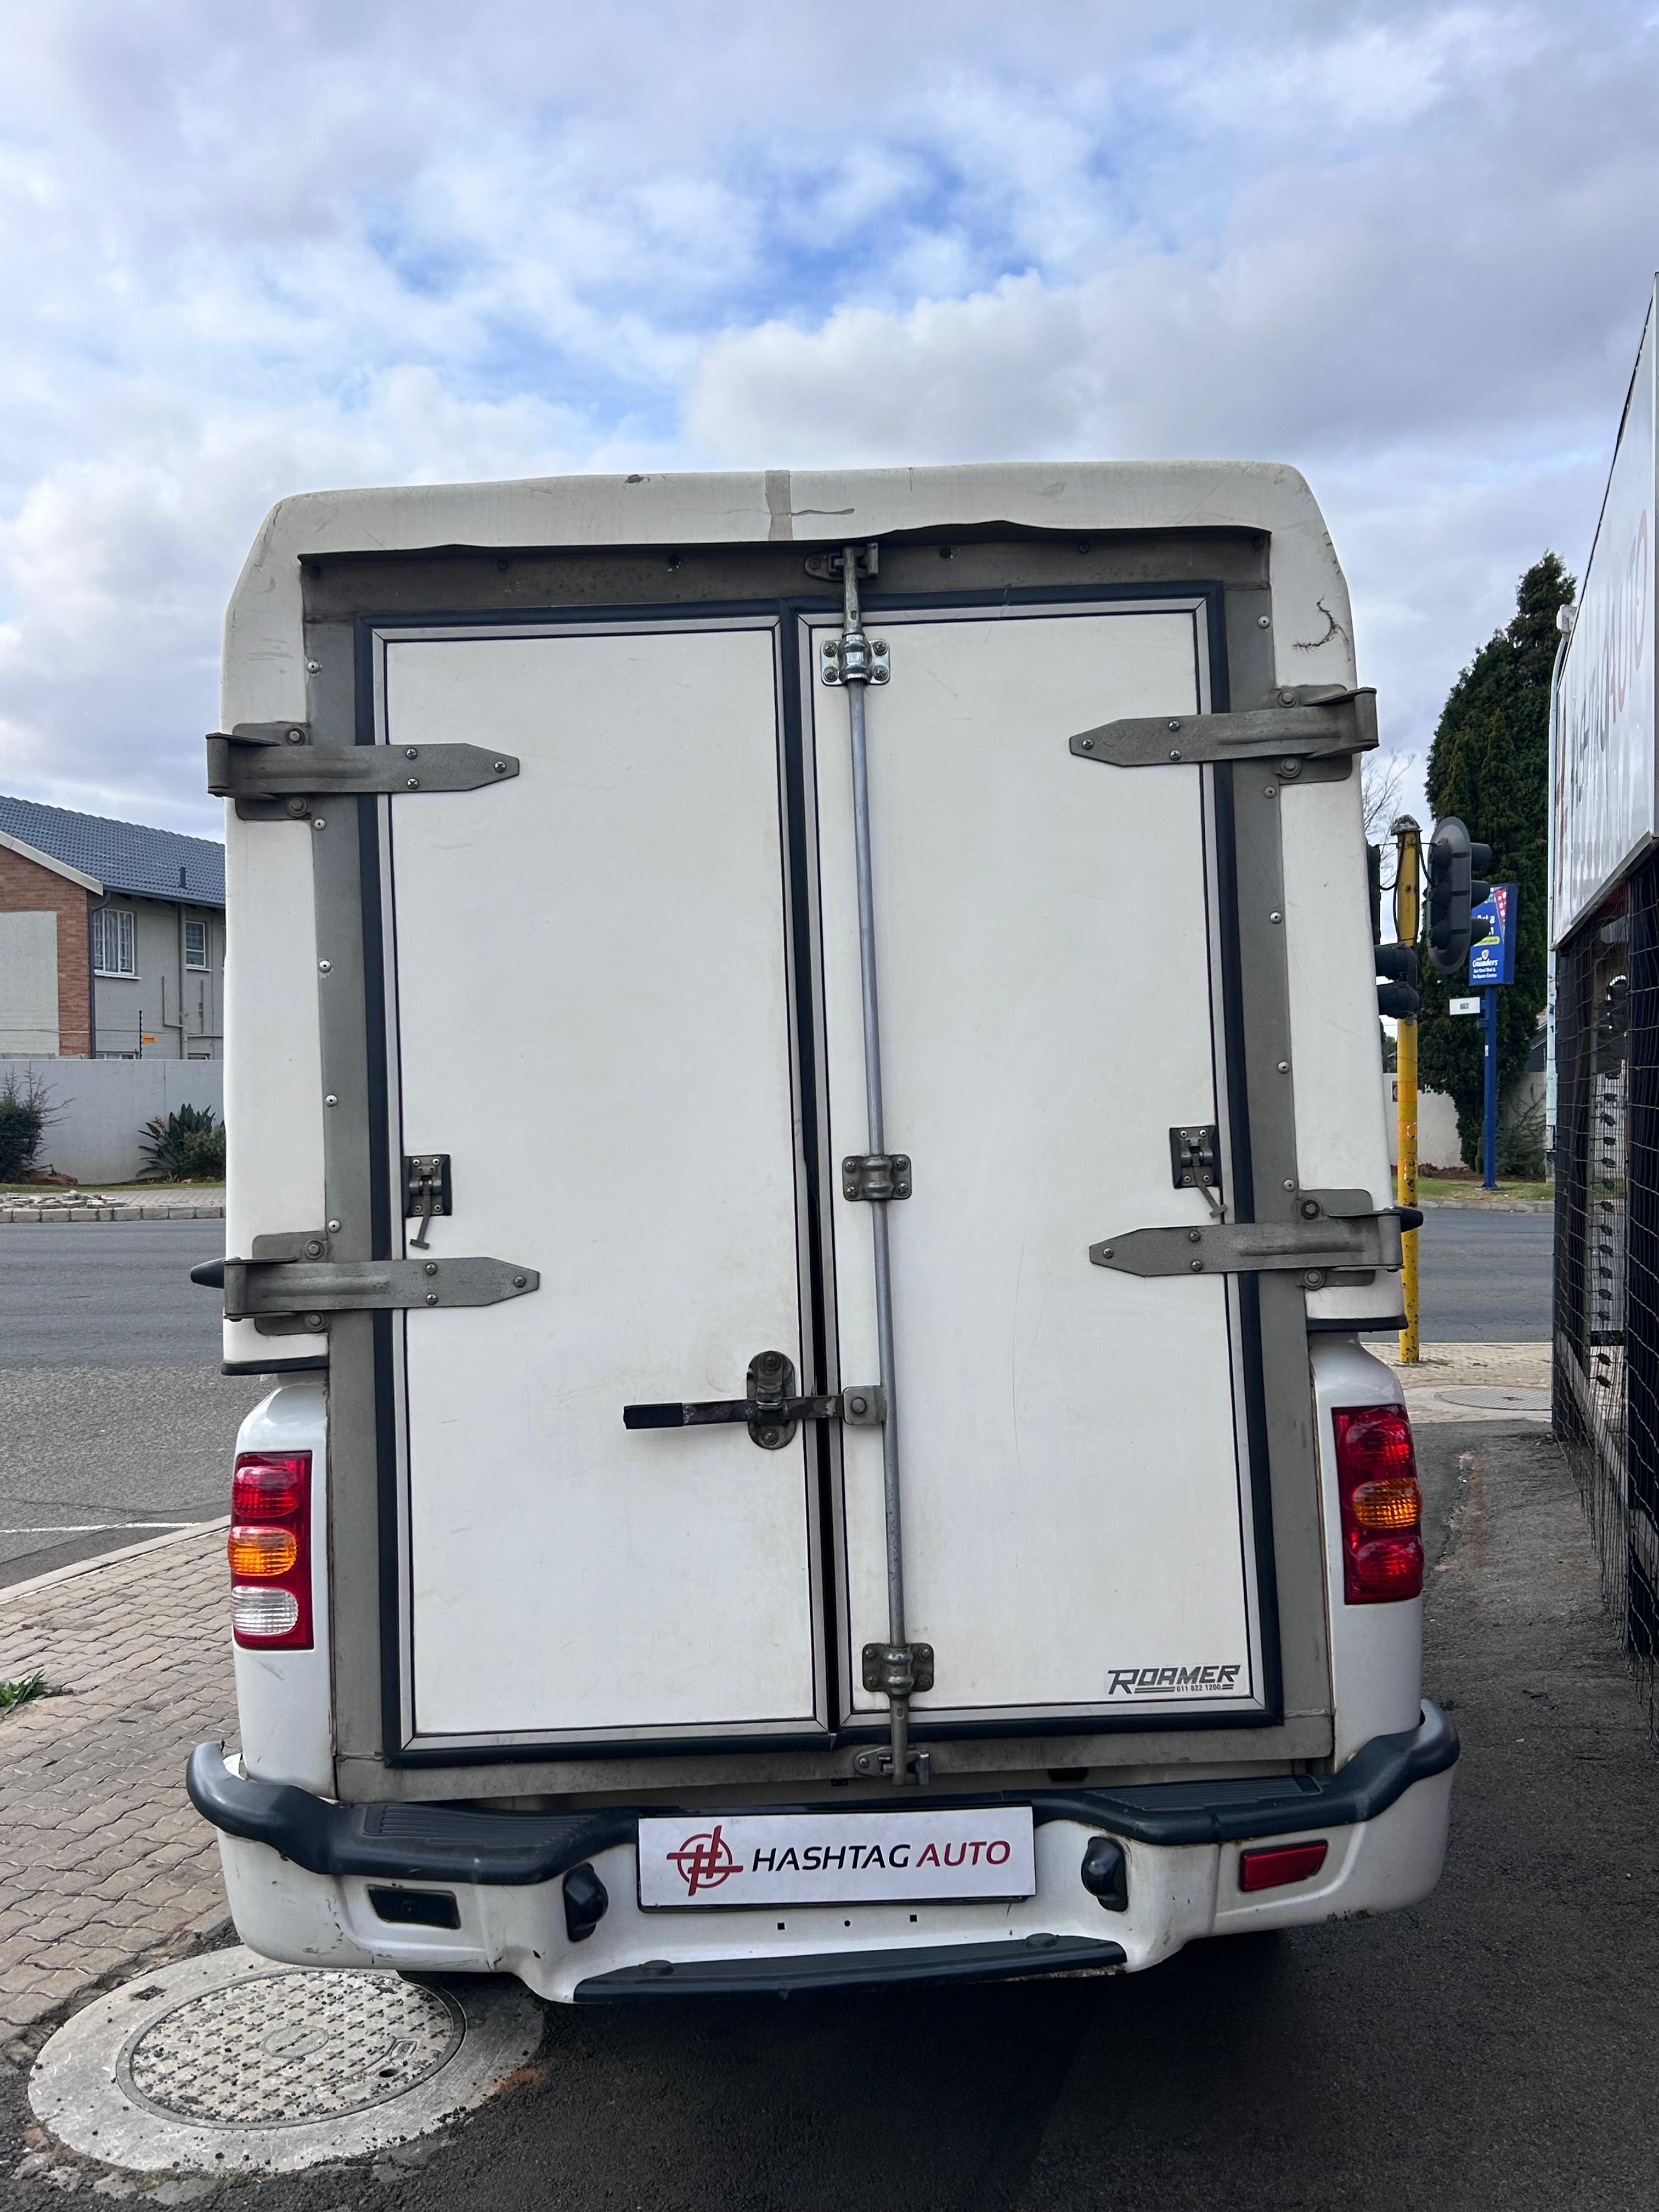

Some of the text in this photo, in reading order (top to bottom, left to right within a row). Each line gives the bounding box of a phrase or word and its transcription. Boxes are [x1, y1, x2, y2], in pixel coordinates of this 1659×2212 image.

[1108, 1665, 1241, 1695] ROAMER
[752, 1840, 1011, 1871] HASHTAG AUTO
